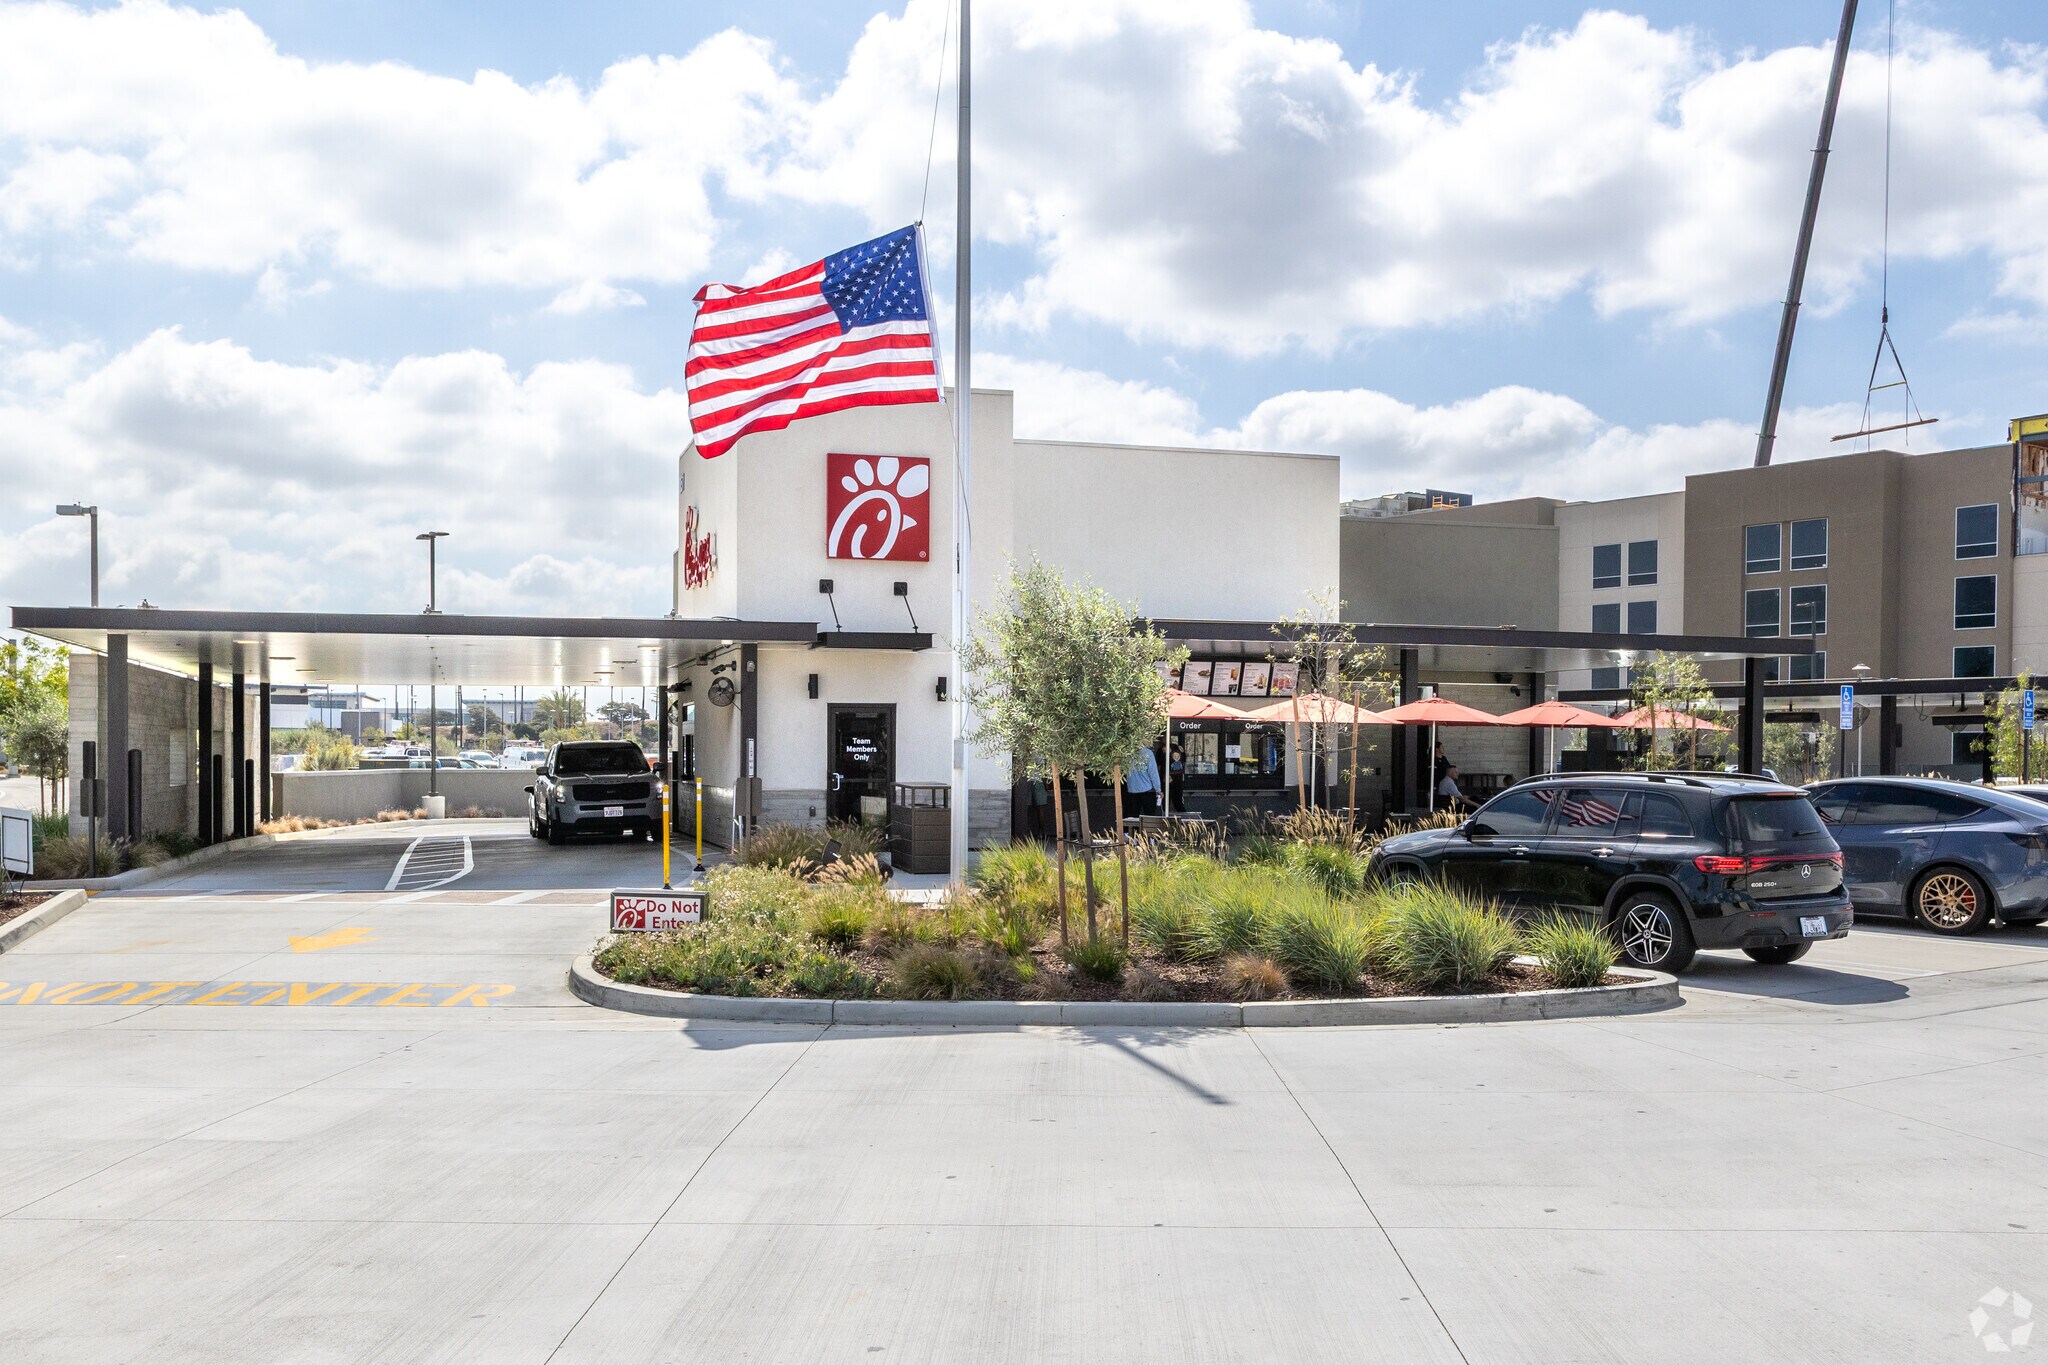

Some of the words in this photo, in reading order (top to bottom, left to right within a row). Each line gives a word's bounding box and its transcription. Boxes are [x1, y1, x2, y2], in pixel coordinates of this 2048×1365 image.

[1180, 721, 1202, 730] Order
[1245, 722, 1264, 730] Order
[853, 754, 870, 762] Only
[646, 899, 667, 913] Do
[671, 900, 699, 914] Not
[652, 916, 693, 930] Enter
[188, 981, 517, 1007] ENTER
